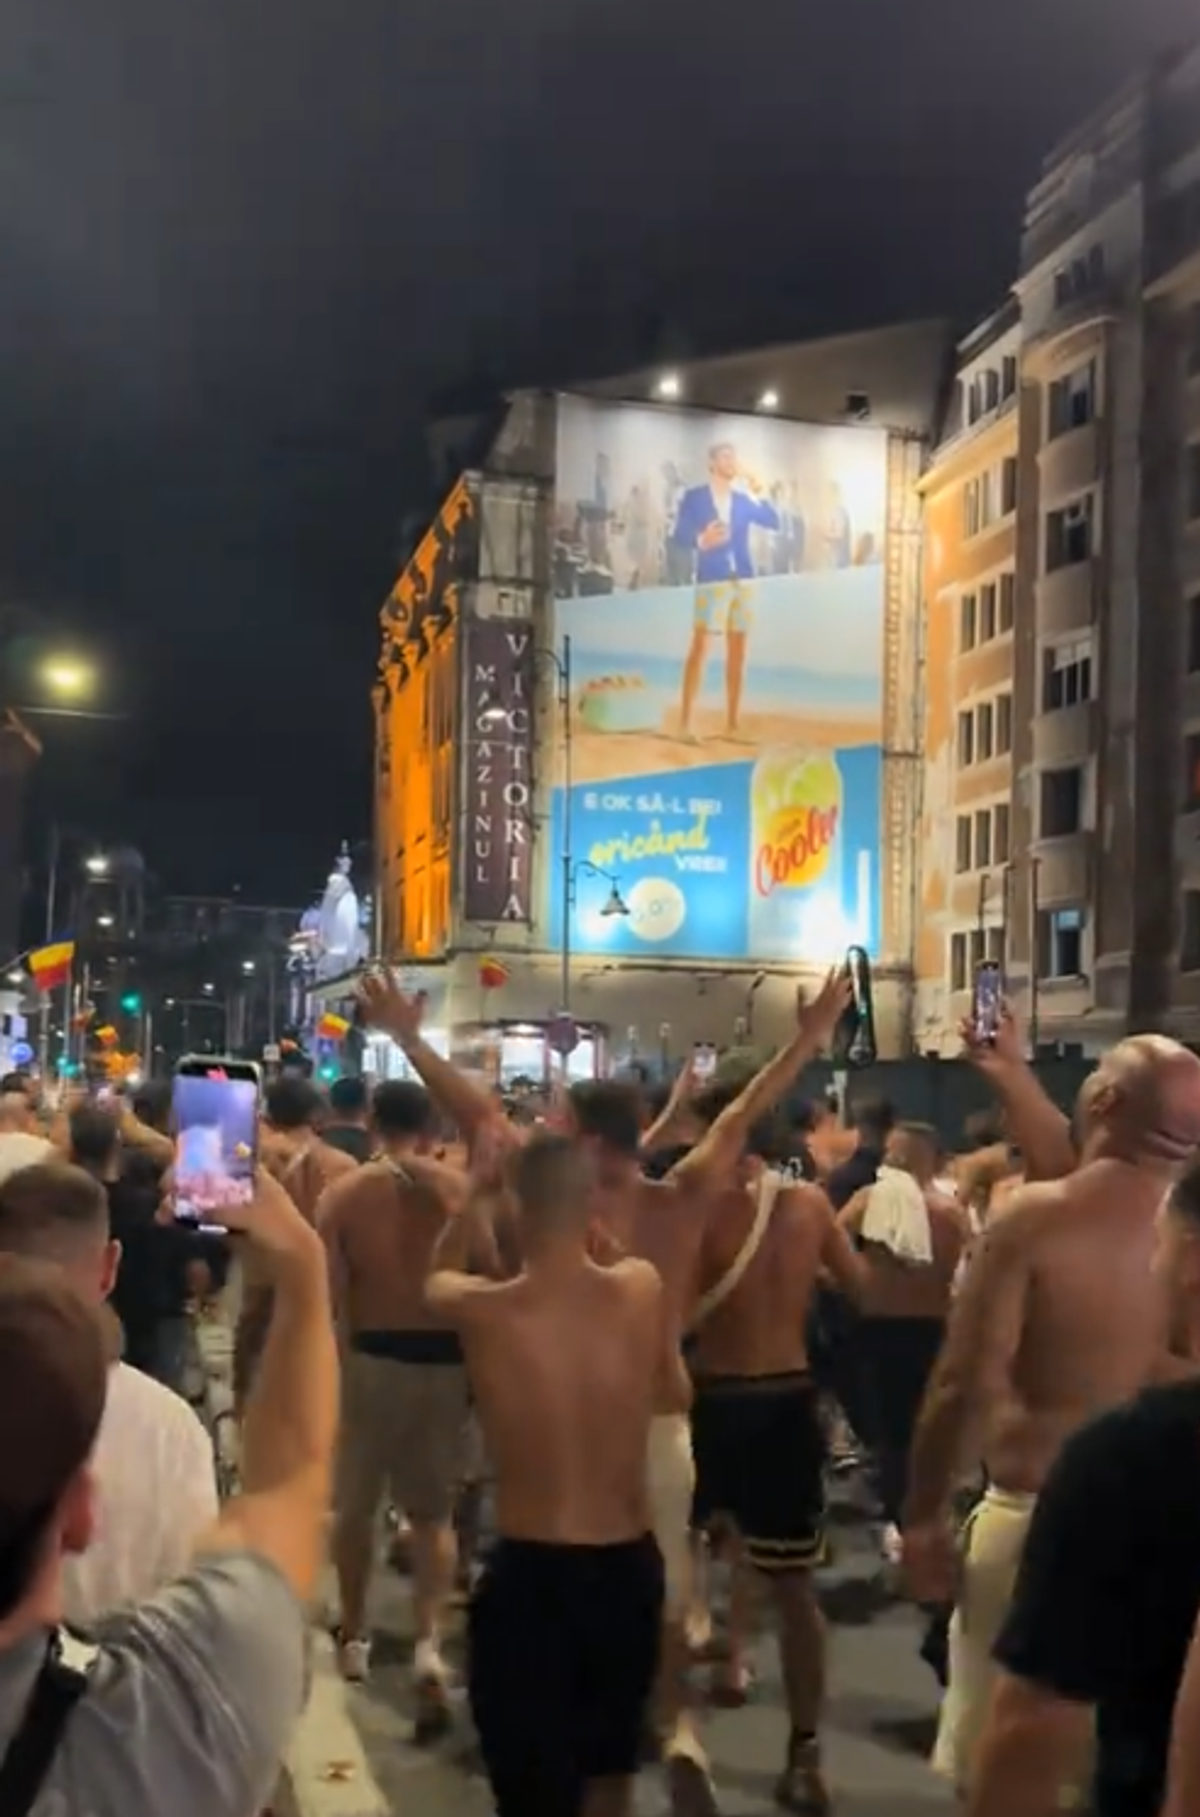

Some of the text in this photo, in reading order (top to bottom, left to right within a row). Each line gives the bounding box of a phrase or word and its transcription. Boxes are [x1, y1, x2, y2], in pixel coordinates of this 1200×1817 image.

[475, 664, 496, 883] MAGAZINUL
[502, 633, 529, 919] VICTORIA
[584, 792, 598, 810] E
[601, 794, 632, 811] OK
